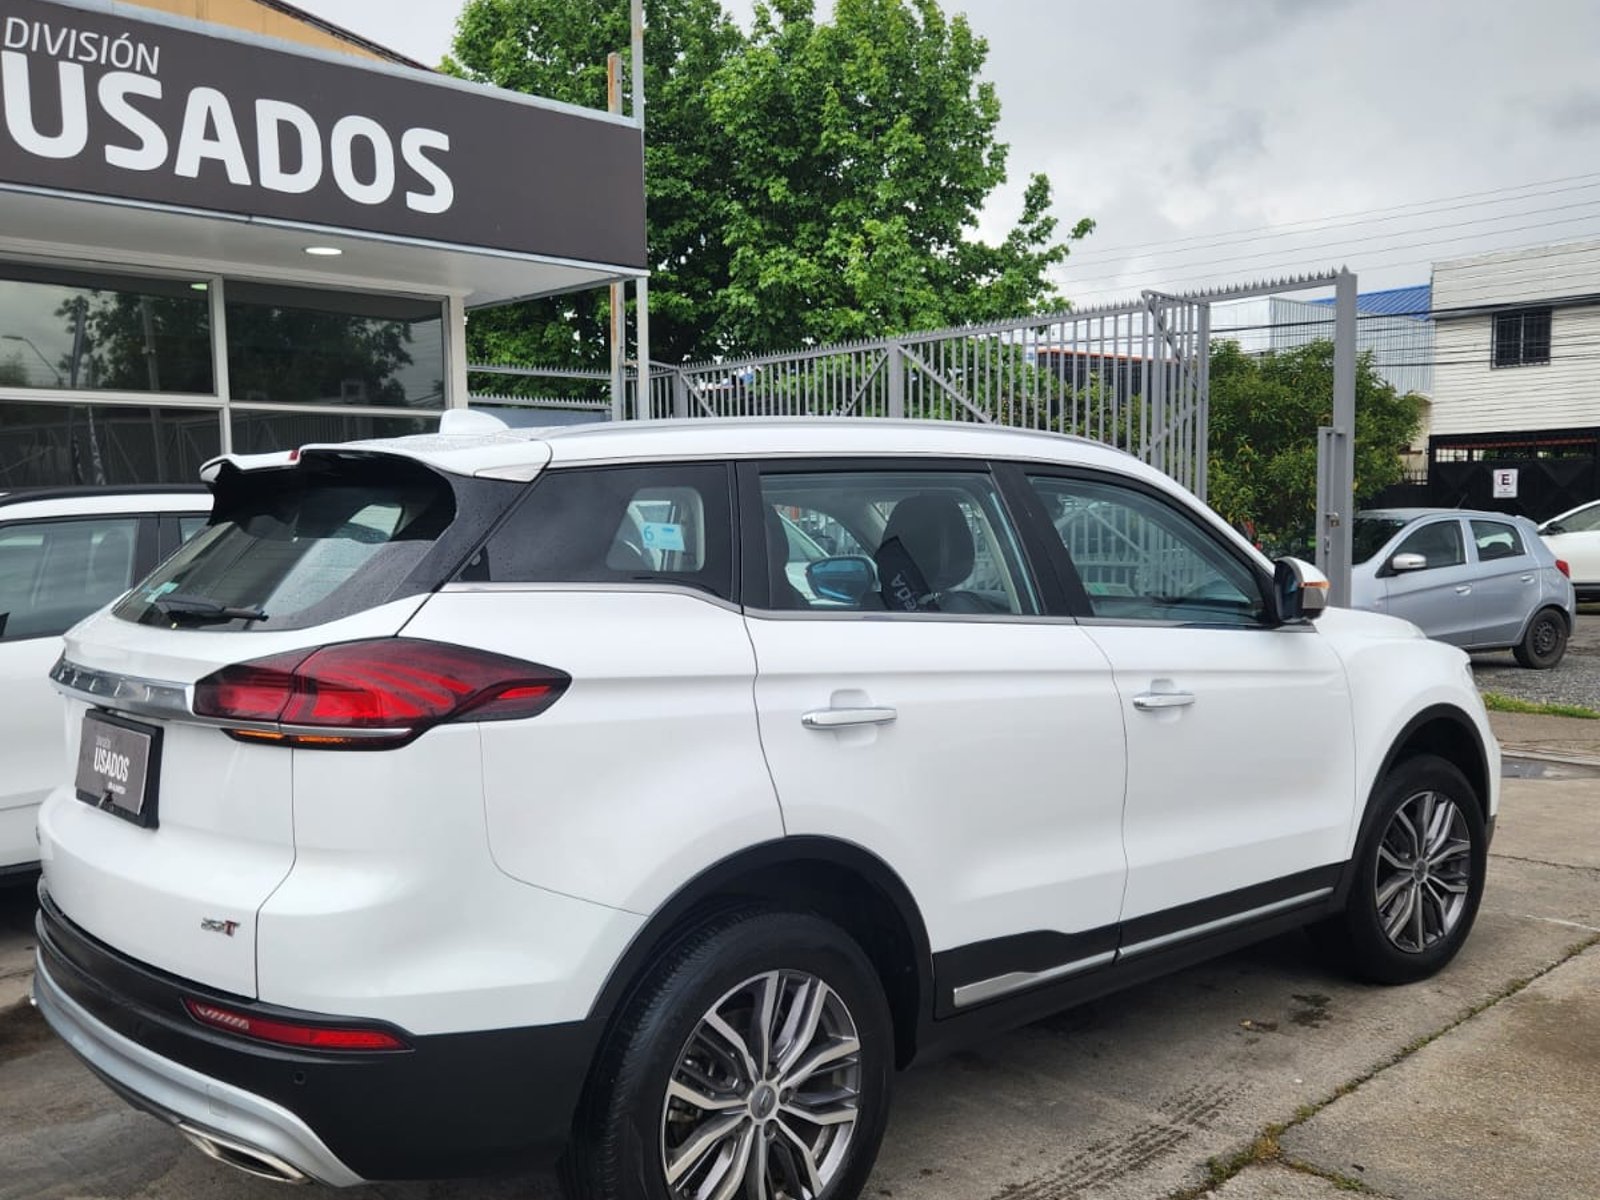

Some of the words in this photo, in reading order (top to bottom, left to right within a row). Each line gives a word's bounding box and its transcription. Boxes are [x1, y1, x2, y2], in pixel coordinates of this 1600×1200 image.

[4, 16, 160, 75] DIVISIÓN
[0, 50, 455, 213] USADOS
[1501, 473, 1511, 486] E
[643, 525, 655, 542] 6
[93, 746, 130, 782] USADOS
